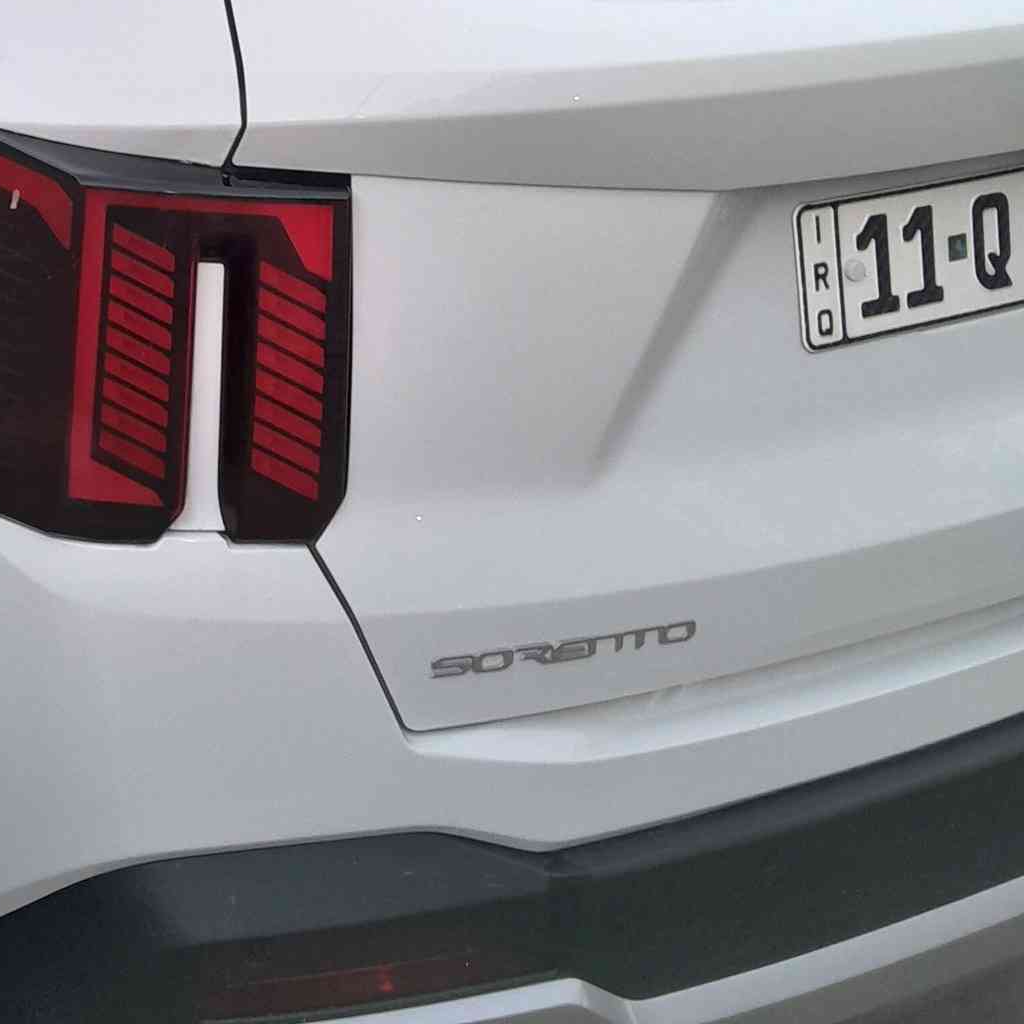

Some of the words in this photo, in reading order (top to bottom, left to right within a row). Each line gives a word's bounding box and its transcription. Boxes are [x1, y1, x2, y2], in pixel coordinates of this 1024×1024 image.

[855, 204, 945, 319] 11
[971, 191, 1014, 291] Q
[431, 619, 697, 678] SORENTO
